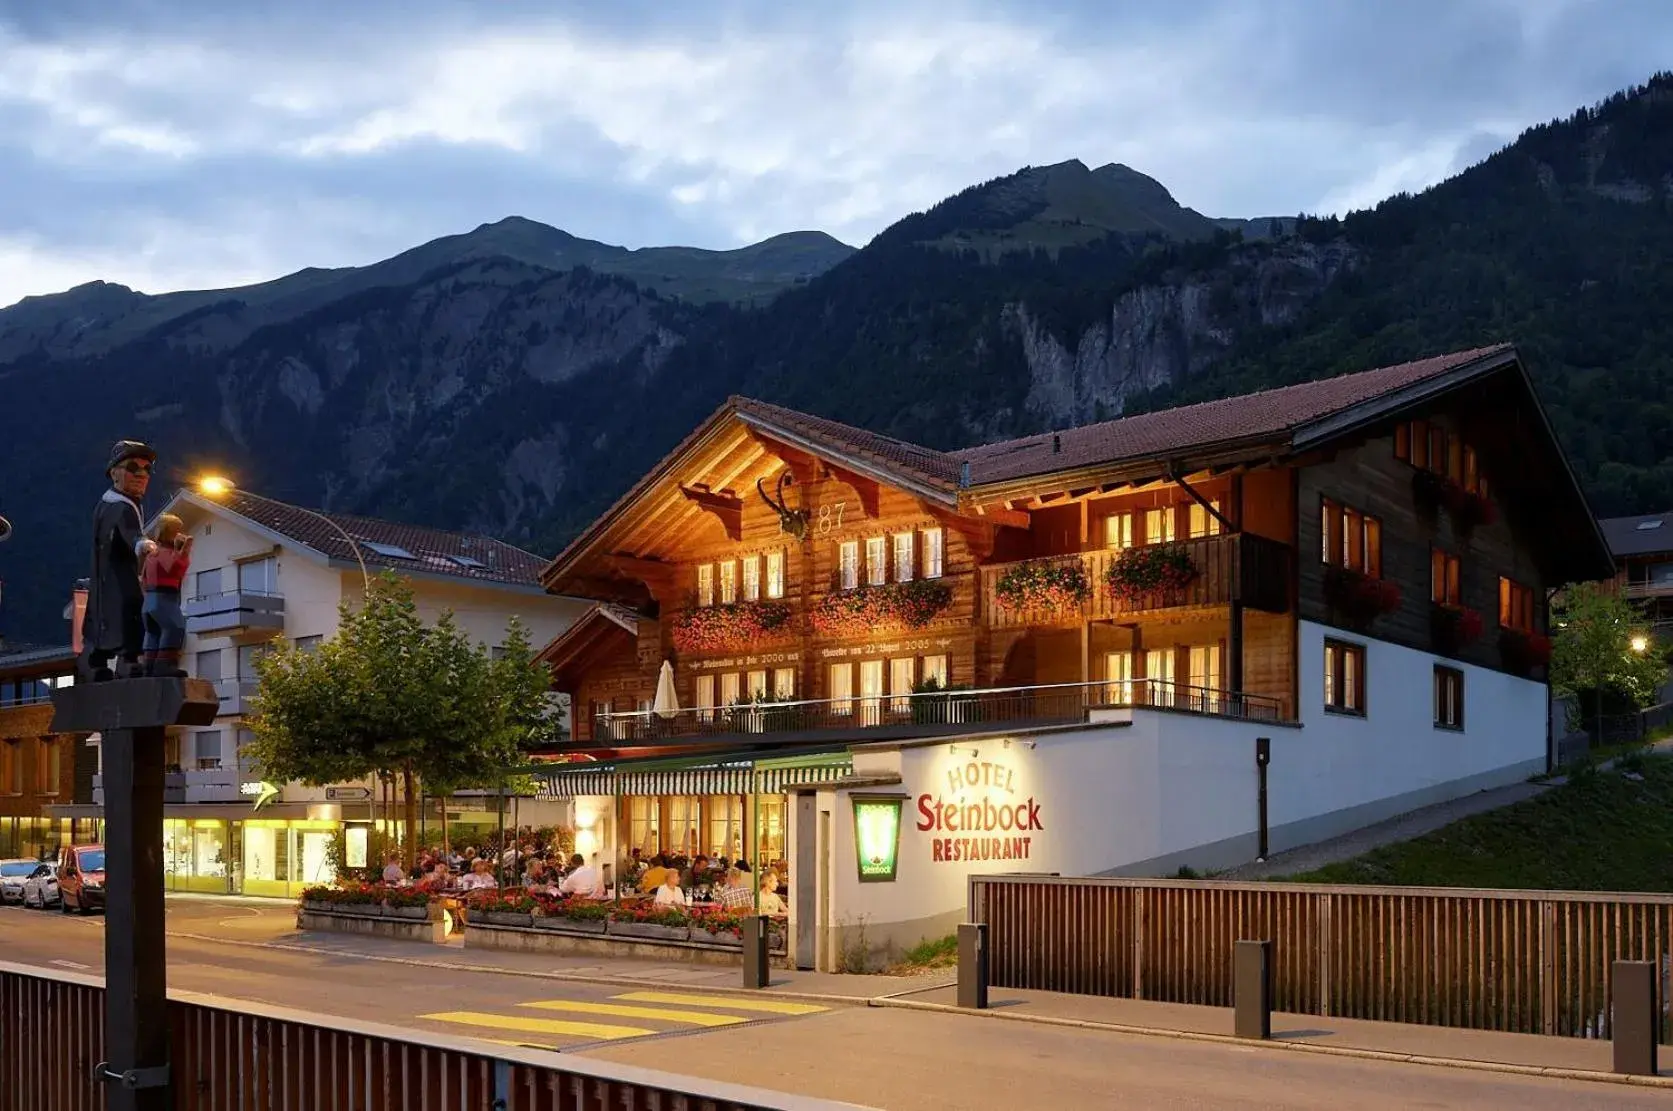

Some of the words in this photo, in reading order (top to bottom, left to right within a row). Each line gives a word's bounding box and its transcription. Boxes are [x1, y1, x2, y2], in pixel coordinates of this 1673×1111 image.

[819, 502, 847, 534] 87
[865, 644, 876, 654] 22
[947, 762, 1016, 795] HOTEL
[916, 793, 1045, 832] Steinbock
[932, 837, 1031, 862] RESTAURANT
